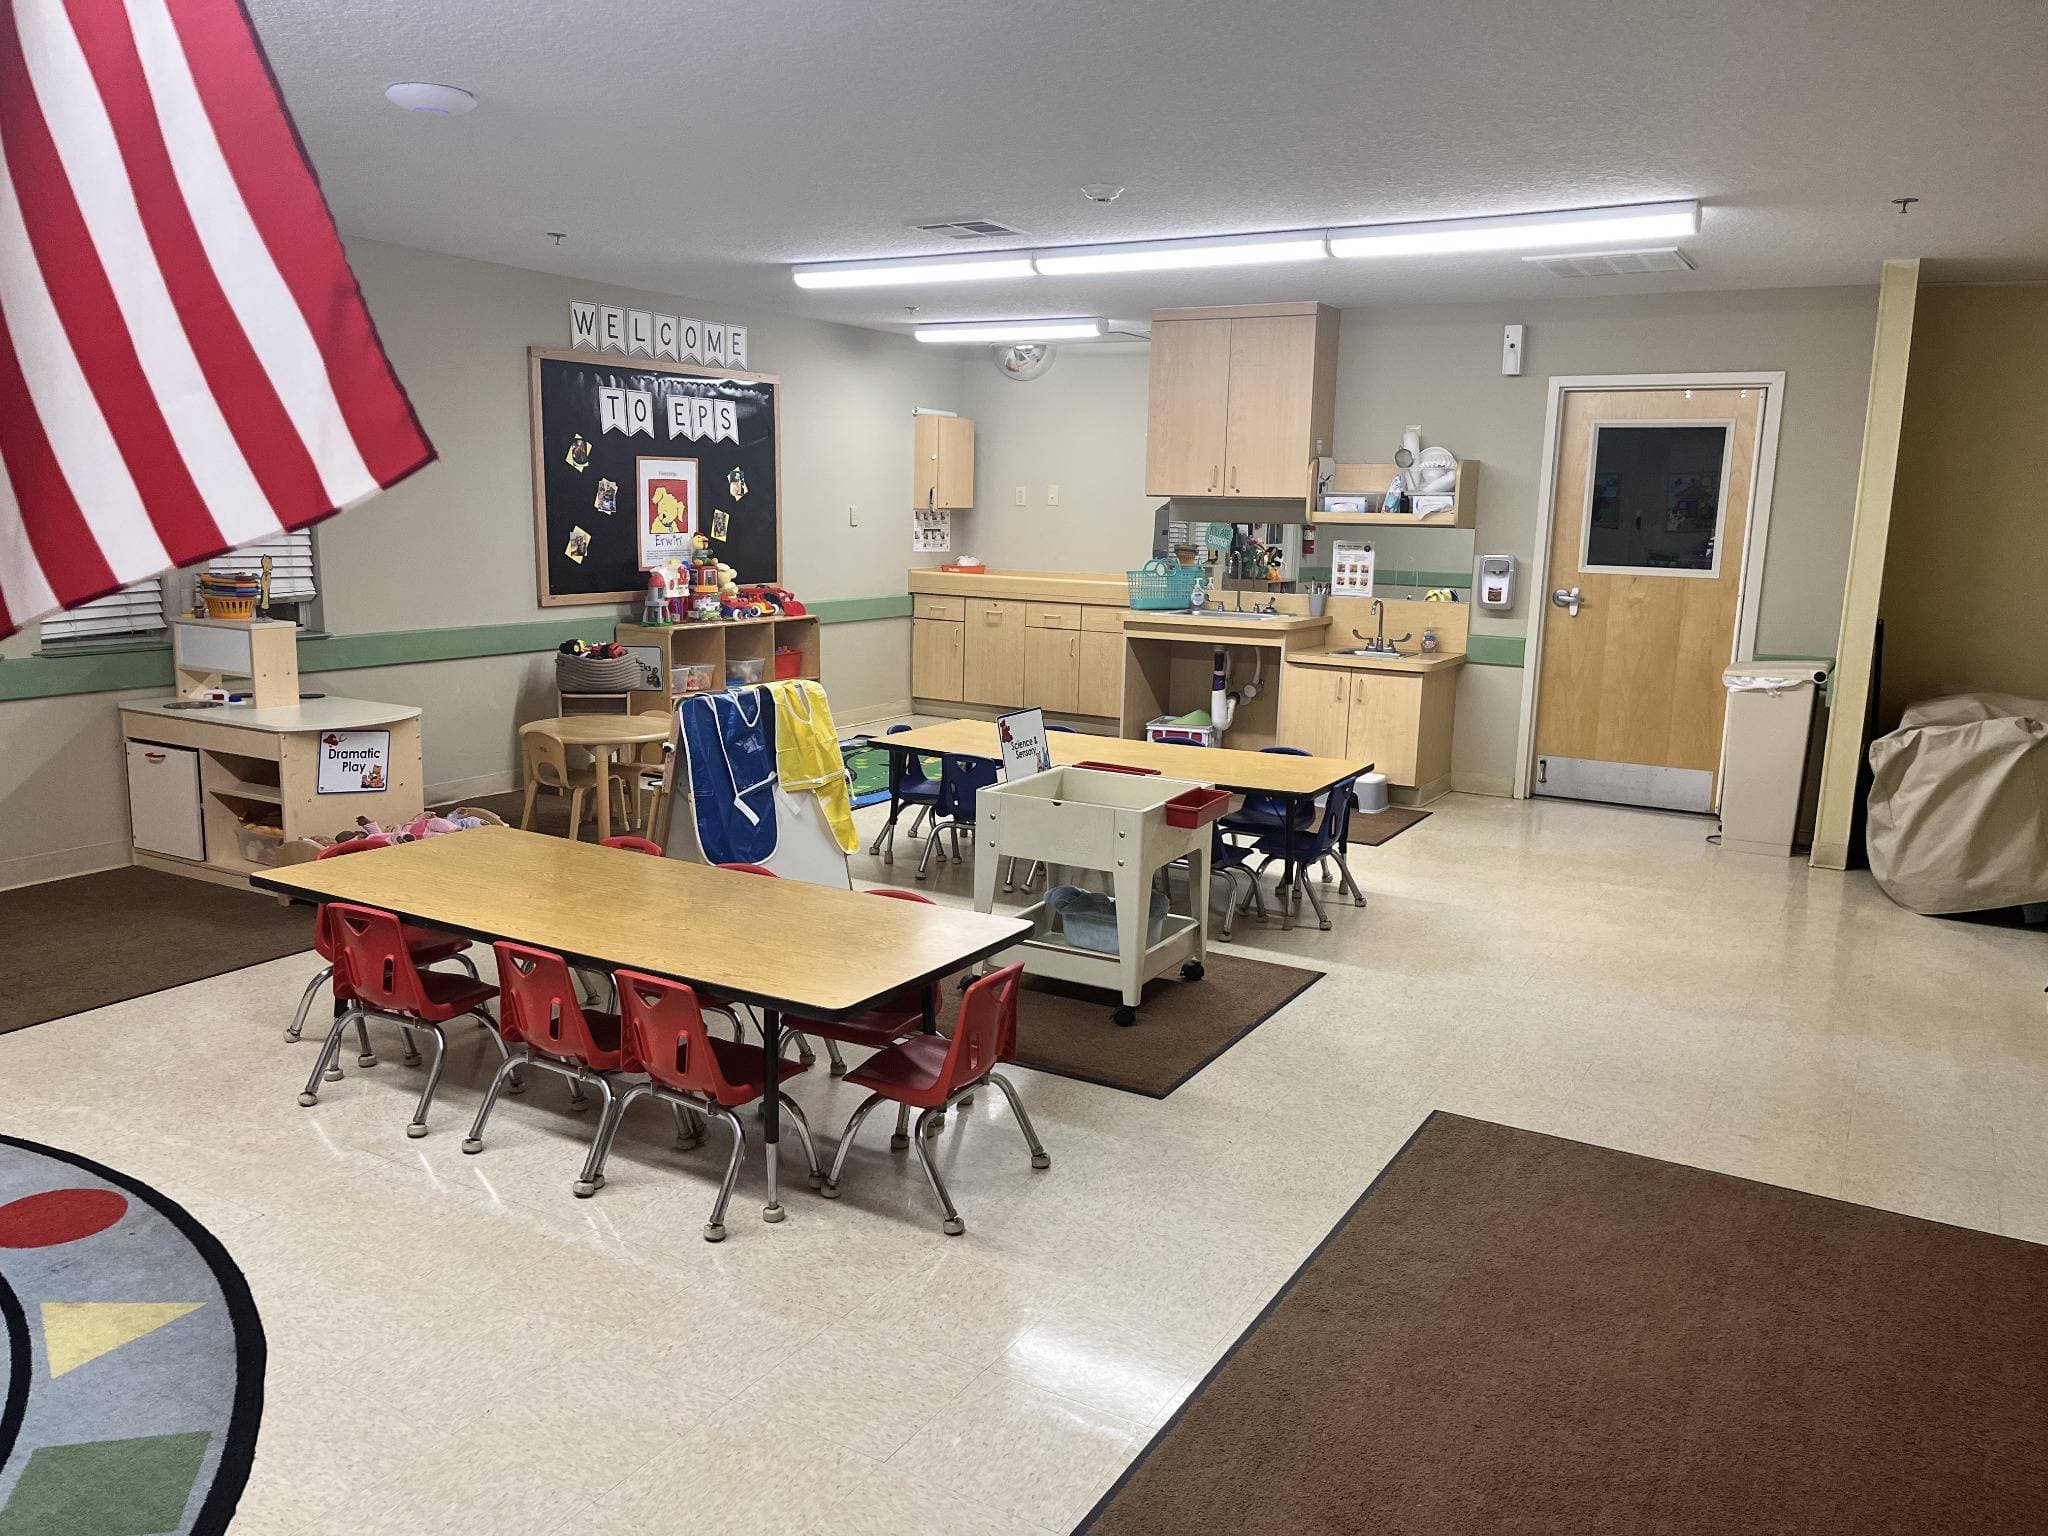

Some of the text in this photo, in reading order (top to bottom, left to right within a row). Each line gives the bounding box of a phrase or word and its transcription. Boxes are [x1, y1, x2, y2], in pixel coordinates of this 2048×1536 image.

[573, 308, 742, 356] WELCOME
[606, 395, 732, 431] TO EPS
[655, 534, 682, 547] Erwin
[1010, 738, 1033, 751] Science
[328, 747, 381, 760] Dramatic
[1015, 746, 1037, 760] Sensory
[342, 761, 367, 774] Play
